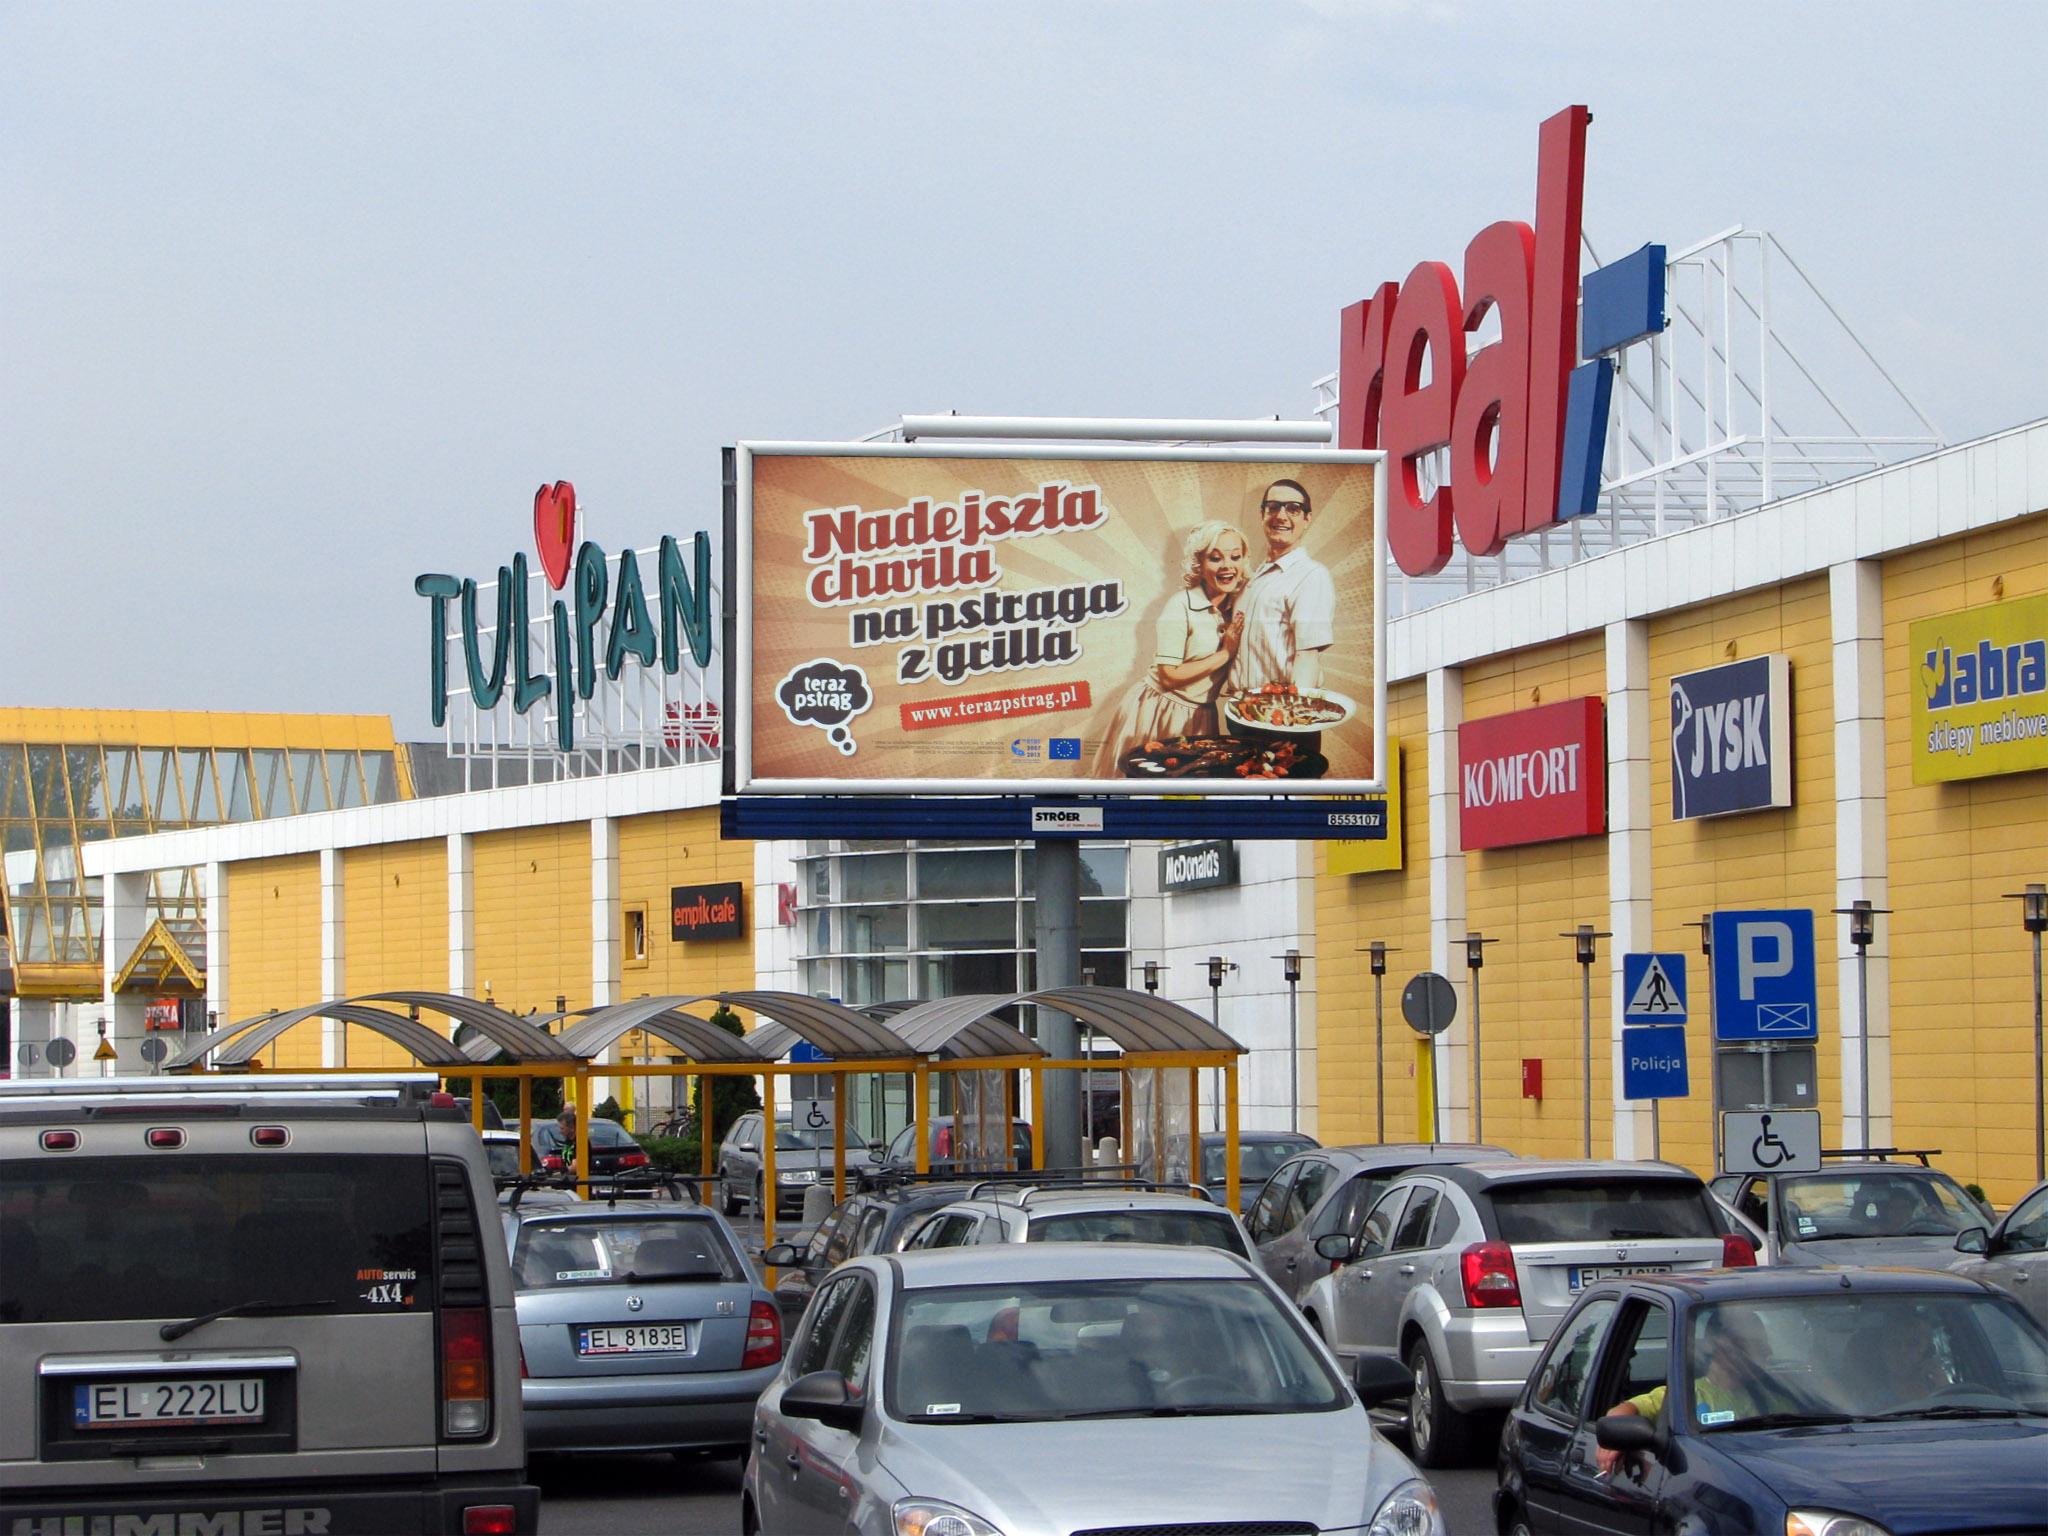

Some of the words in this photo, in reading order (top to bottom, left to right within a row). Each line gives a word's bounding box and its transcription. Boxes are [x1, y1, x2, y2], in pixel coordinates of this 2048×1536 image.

[809, 485, 1103, 558] Nadejszła
[811, 545, 997, 602] chwila
[415, 530, 713, 752] TULIPAN
[853, 607, 919, 643] na
[901, 649, 930, 679] z
[937, 627, 1078, 681] grilla
[795, 690, 852, 711] pstrąg
[804, 676, 847, 691] teraz
[910, 685, 1078, 722] www.terazpstrag.pl
[1691, 694, 1767, 778] JYSK
[1928, 720, 1974, 757] sklepy
[1980, 710, 2048, 745] meblowe
[1464, 743, 1581, 808] KOMFORT
[1330, 815, 1379, 826] 8553107
[1165, 850, 1220, 885] McDonald's
[674, 896, 710, 929] empik
[1737, 922, 1794, 1000] P
[1632, 1056, 1681, 1073] Policja
[357, 1268, 416, 1280] AUTOserwis
[591, 1330, 617, 1348] EL
[625, 1328, 683, 1346] 8183E
[75, 1408, 88, 1417] PL
[95, 1387, 141, 1418] EL
[156, 1383, 259, 1416] 222LU
[12, 1507, 332, 1536] HUMMER
